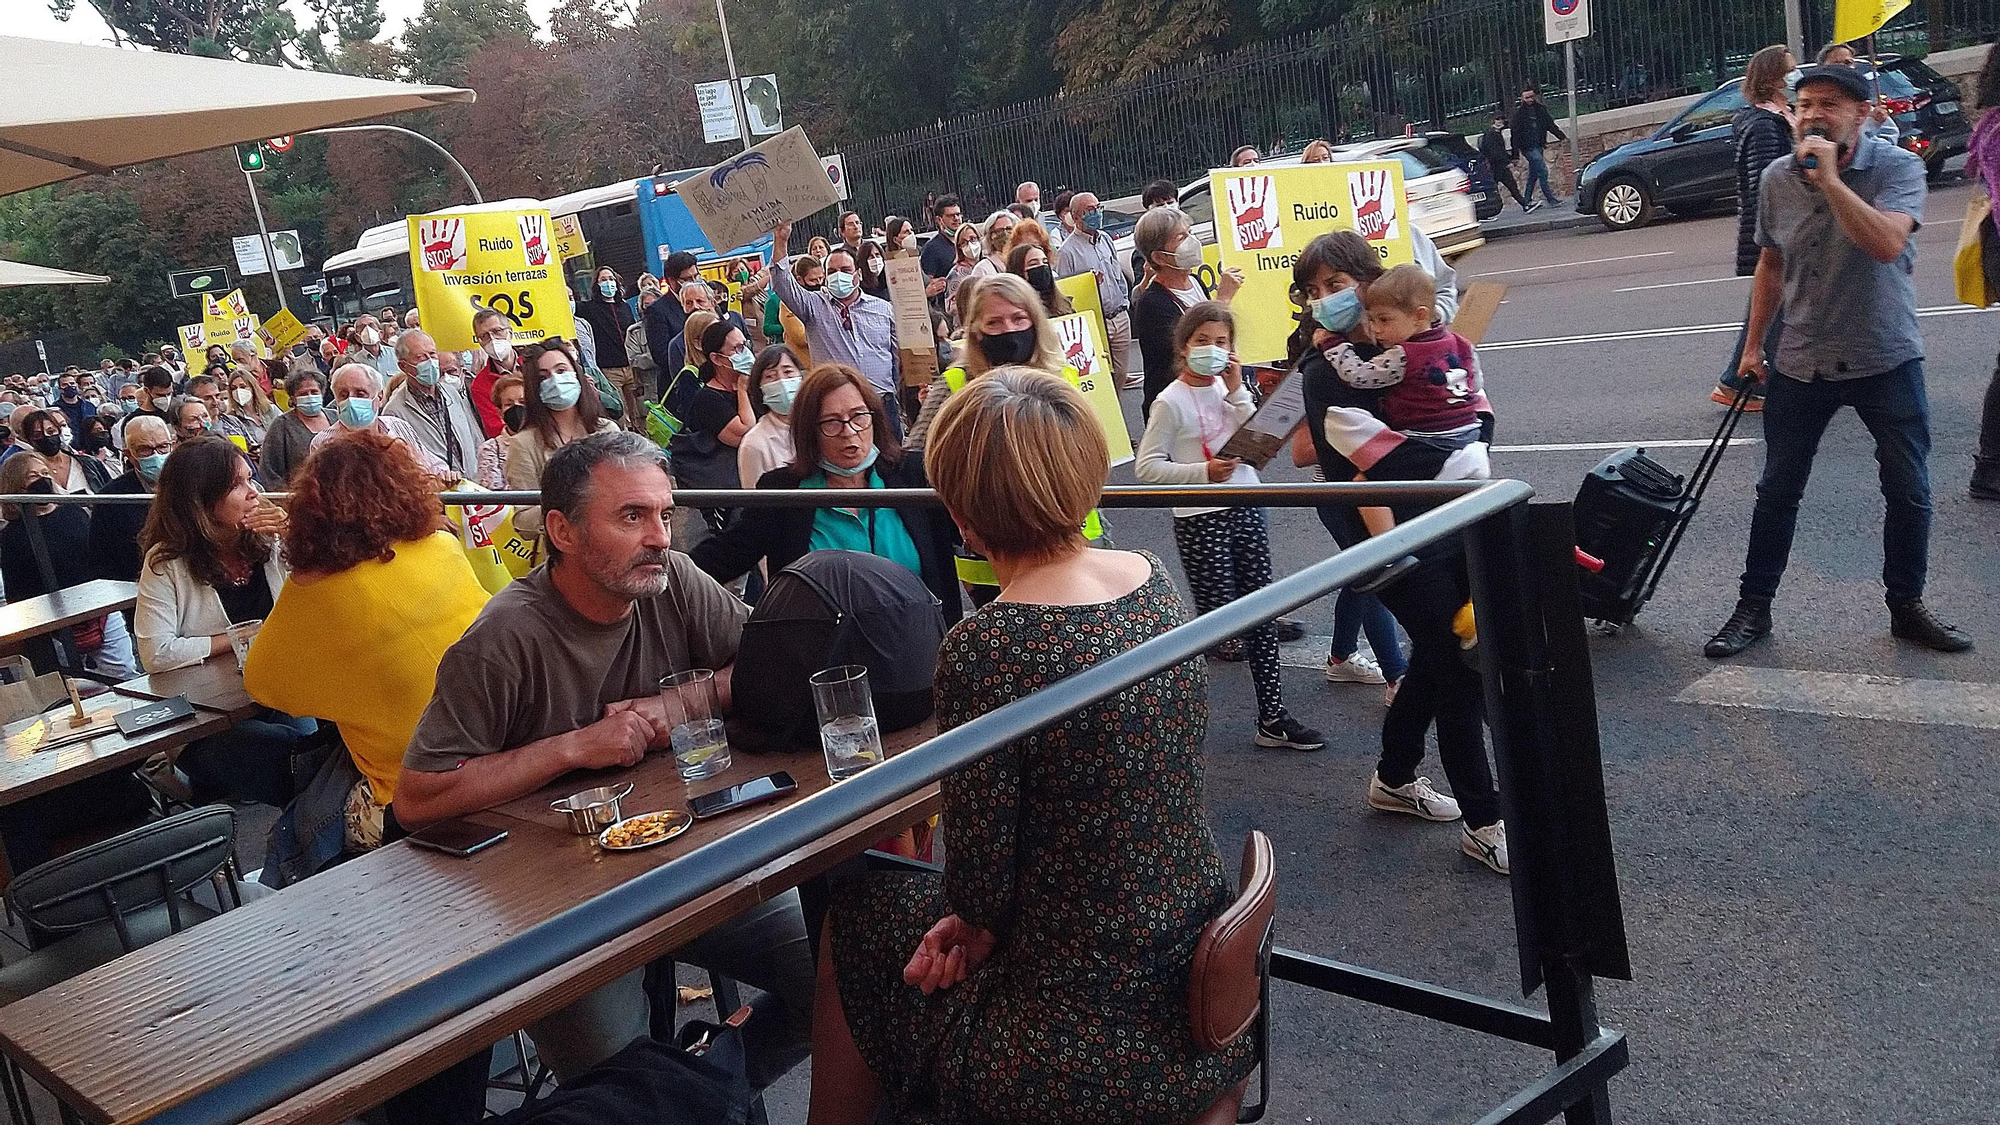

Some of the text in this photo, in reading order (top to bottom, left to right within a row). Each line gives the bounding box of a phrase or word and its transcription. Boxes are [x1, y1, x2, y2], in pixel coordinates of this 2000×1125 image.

[1293, 201, 1338, 221] Ruido
[1237, 217, 1266, 245] STOP
[1359, 211, 1384, 237] STOP
[479, 237, 513, 251] Ruido
[426, 249, 451, 267] STOP
[527, 245, 543, 262] STOP
[443, 269, 548, 286] Invasión terrazas
[514, 329, 545, 340] RETIRO
